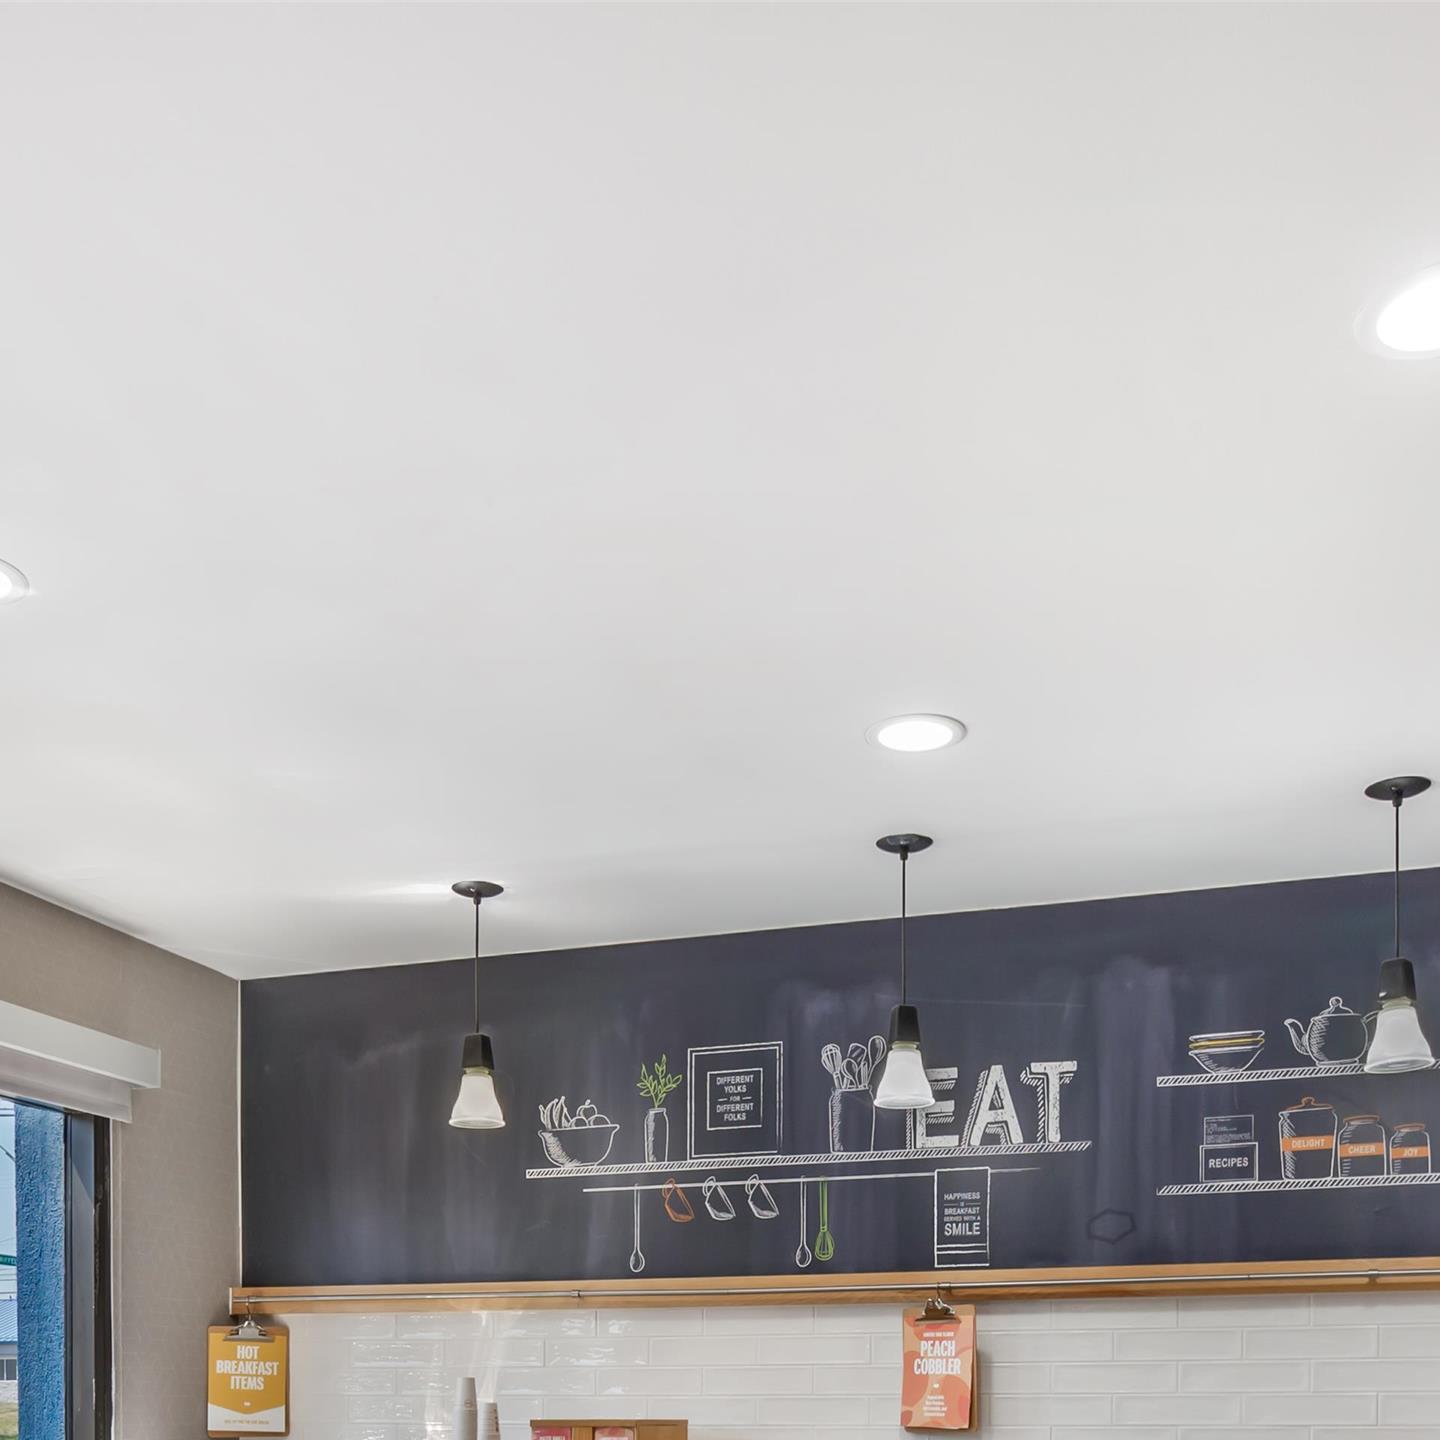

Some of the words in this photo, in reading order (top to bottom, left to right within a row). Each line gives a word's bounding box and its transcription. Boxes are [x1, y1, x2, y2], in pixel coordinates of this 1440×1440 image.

[716, 1075, 754, 1085] DIFFERENT
[724, 1084, 747, 1093] YOLKS
[716, 1103, 754, 1113] DIFFERENT
[907, 1060, 1078, 1149] EAT
[724, 1112, 747, 1121] FOLKS
[1291, 1138, 1325, 1148] DELIGHT
[1348, 1144, 1376, 1154] CHEER
[1403, 1148, 1418, 1157] JOY
[1208, 1157, 1249, 1168] RECIPES
[943, 1192, 981, 1200] HAPPINESS
[944, 1207, 981, 1215] BREAKFAST
[944, 1222, 981, 1236] SMILE
[236, 1345, 260, 1359] HOT
[920, 1340, 956, 1357] PEACH
[216, 1360, 279, 1375] BREAKFAST
[914, 1358, 961, 1375] COBBLER
[230, 1376, 264, 1391] ITEMS
